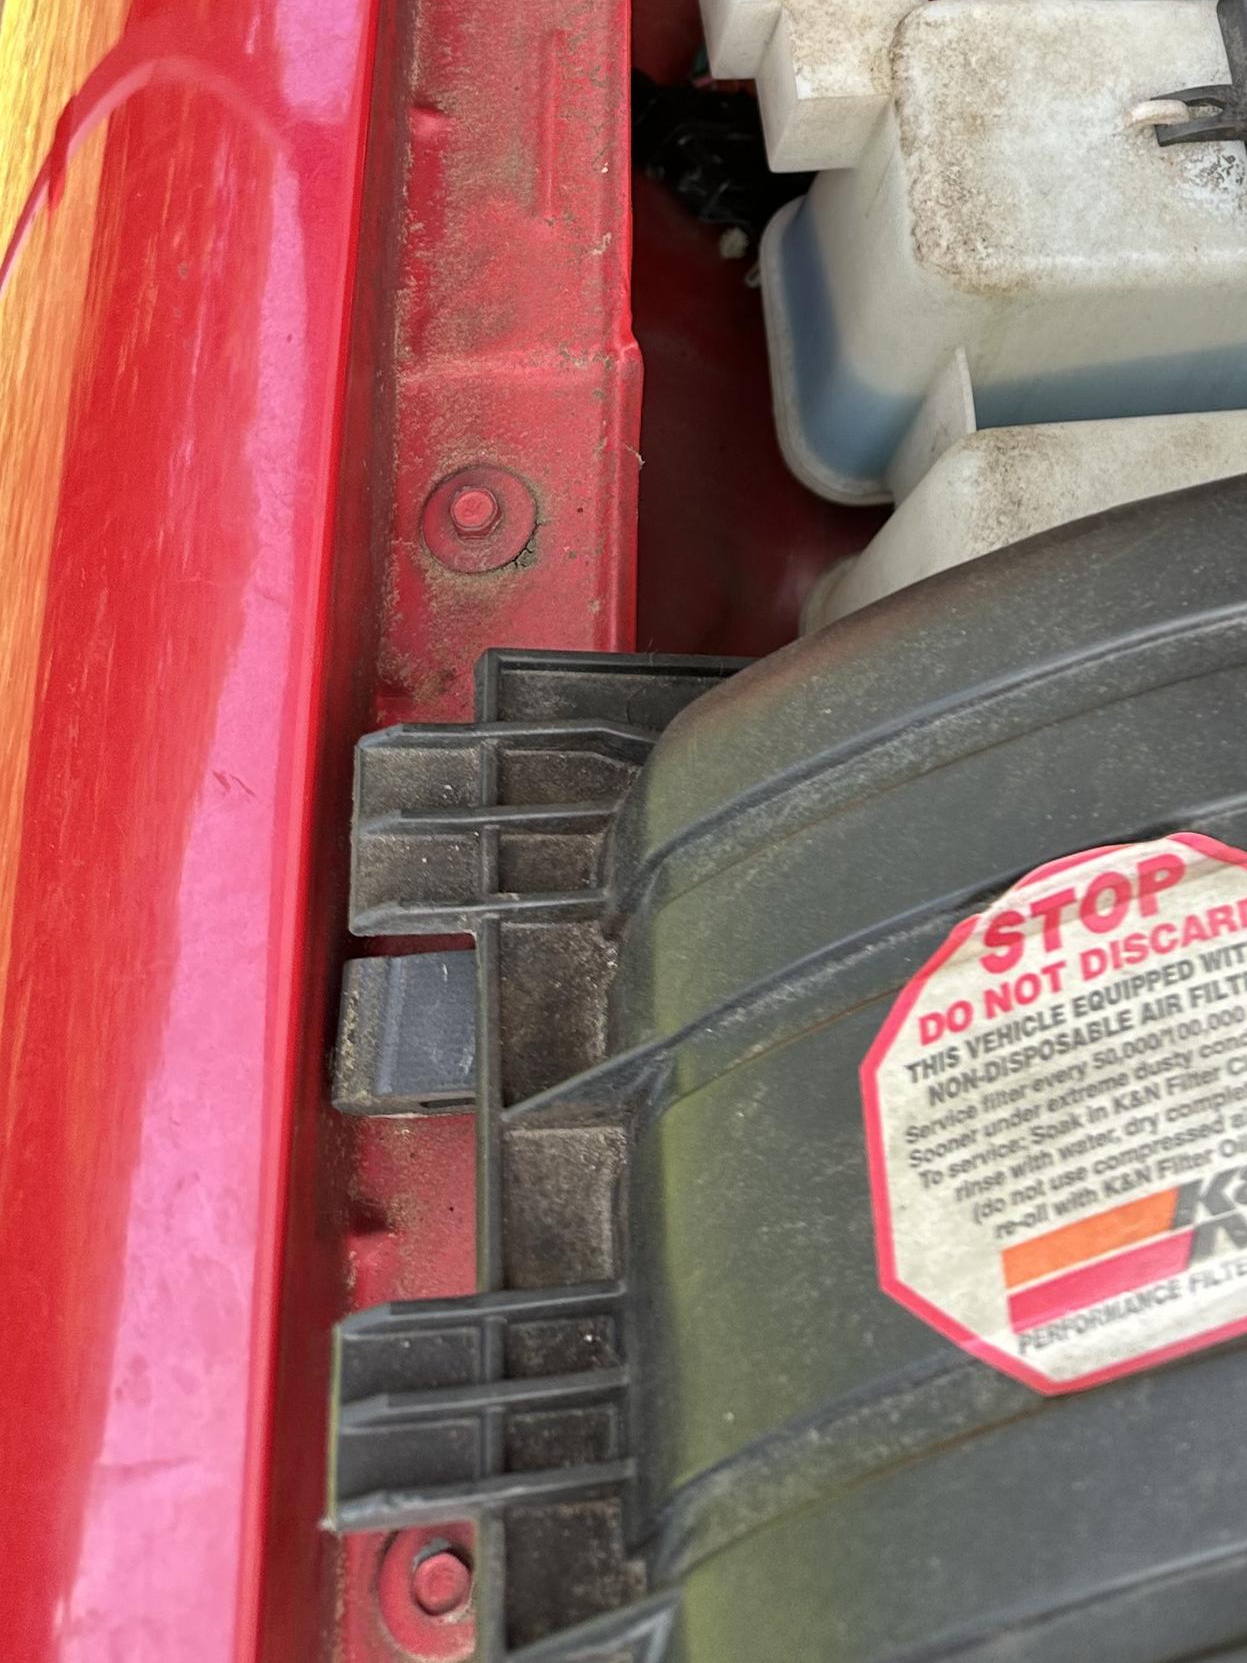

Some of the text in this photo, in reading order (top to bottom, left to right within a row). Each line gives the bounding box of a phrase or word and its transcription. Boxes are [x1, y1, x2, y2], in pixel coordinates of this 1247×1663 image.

[980, 853, 1187, 974] STOP
[905, 1046, 960, 1084] THIS
[966, 1004, 1066, 1059] VEHICLE
[1072, 959, 1195, 1018] EQUIPPED
[918, 1000, 974, 1047] DO
[983, 960, 1067, 1020] NOT
[928, 1009, 1134, 1108] NON-DISPOSABLE
[1141, 993, 1183, 1026] AIR
[906, 1104, 978, 1144] Service
[983, 1084, 1028, 1113] filter
[1033, 1061, 1089, 1092] every
[909, 1128, 978, 1169] Sooner
[984, 1104, 1042, 1137] under
[1047, 1072, 1129, 1113] extreme
[1134, 1049, 1194, 1082] dusty
[919, 1169, 945, 1189] To
[1031, 1113, 1084, 1145] Soak
[1088, 1105, 1109, 1124] in
[1113, 1082, 1161, 1114] K&N
[1166, 1066, 1222, 1096] Filter
[956, 1170, 1006, 1202] rinse
[1010, 1150, 1054, 1179] with
[1124, 1111, 1159, 1136] dry
[973, 1197, 1006, 1226] (do
[1012, 1177, 1047, 1206] not
[1051, 1166, 1088, 1190] use
[1093, 1114, 1226, 1175] compressed
[996, 1202, 1050, 1239] re-oil
[1053, 1186, 1099, 1216] with
[1103, 1163, 1153, 1198] K&N
[1157, 1149, 1214, 1180] Filter
[1018, 1277, 1183, 1355] PERFORMANCE
